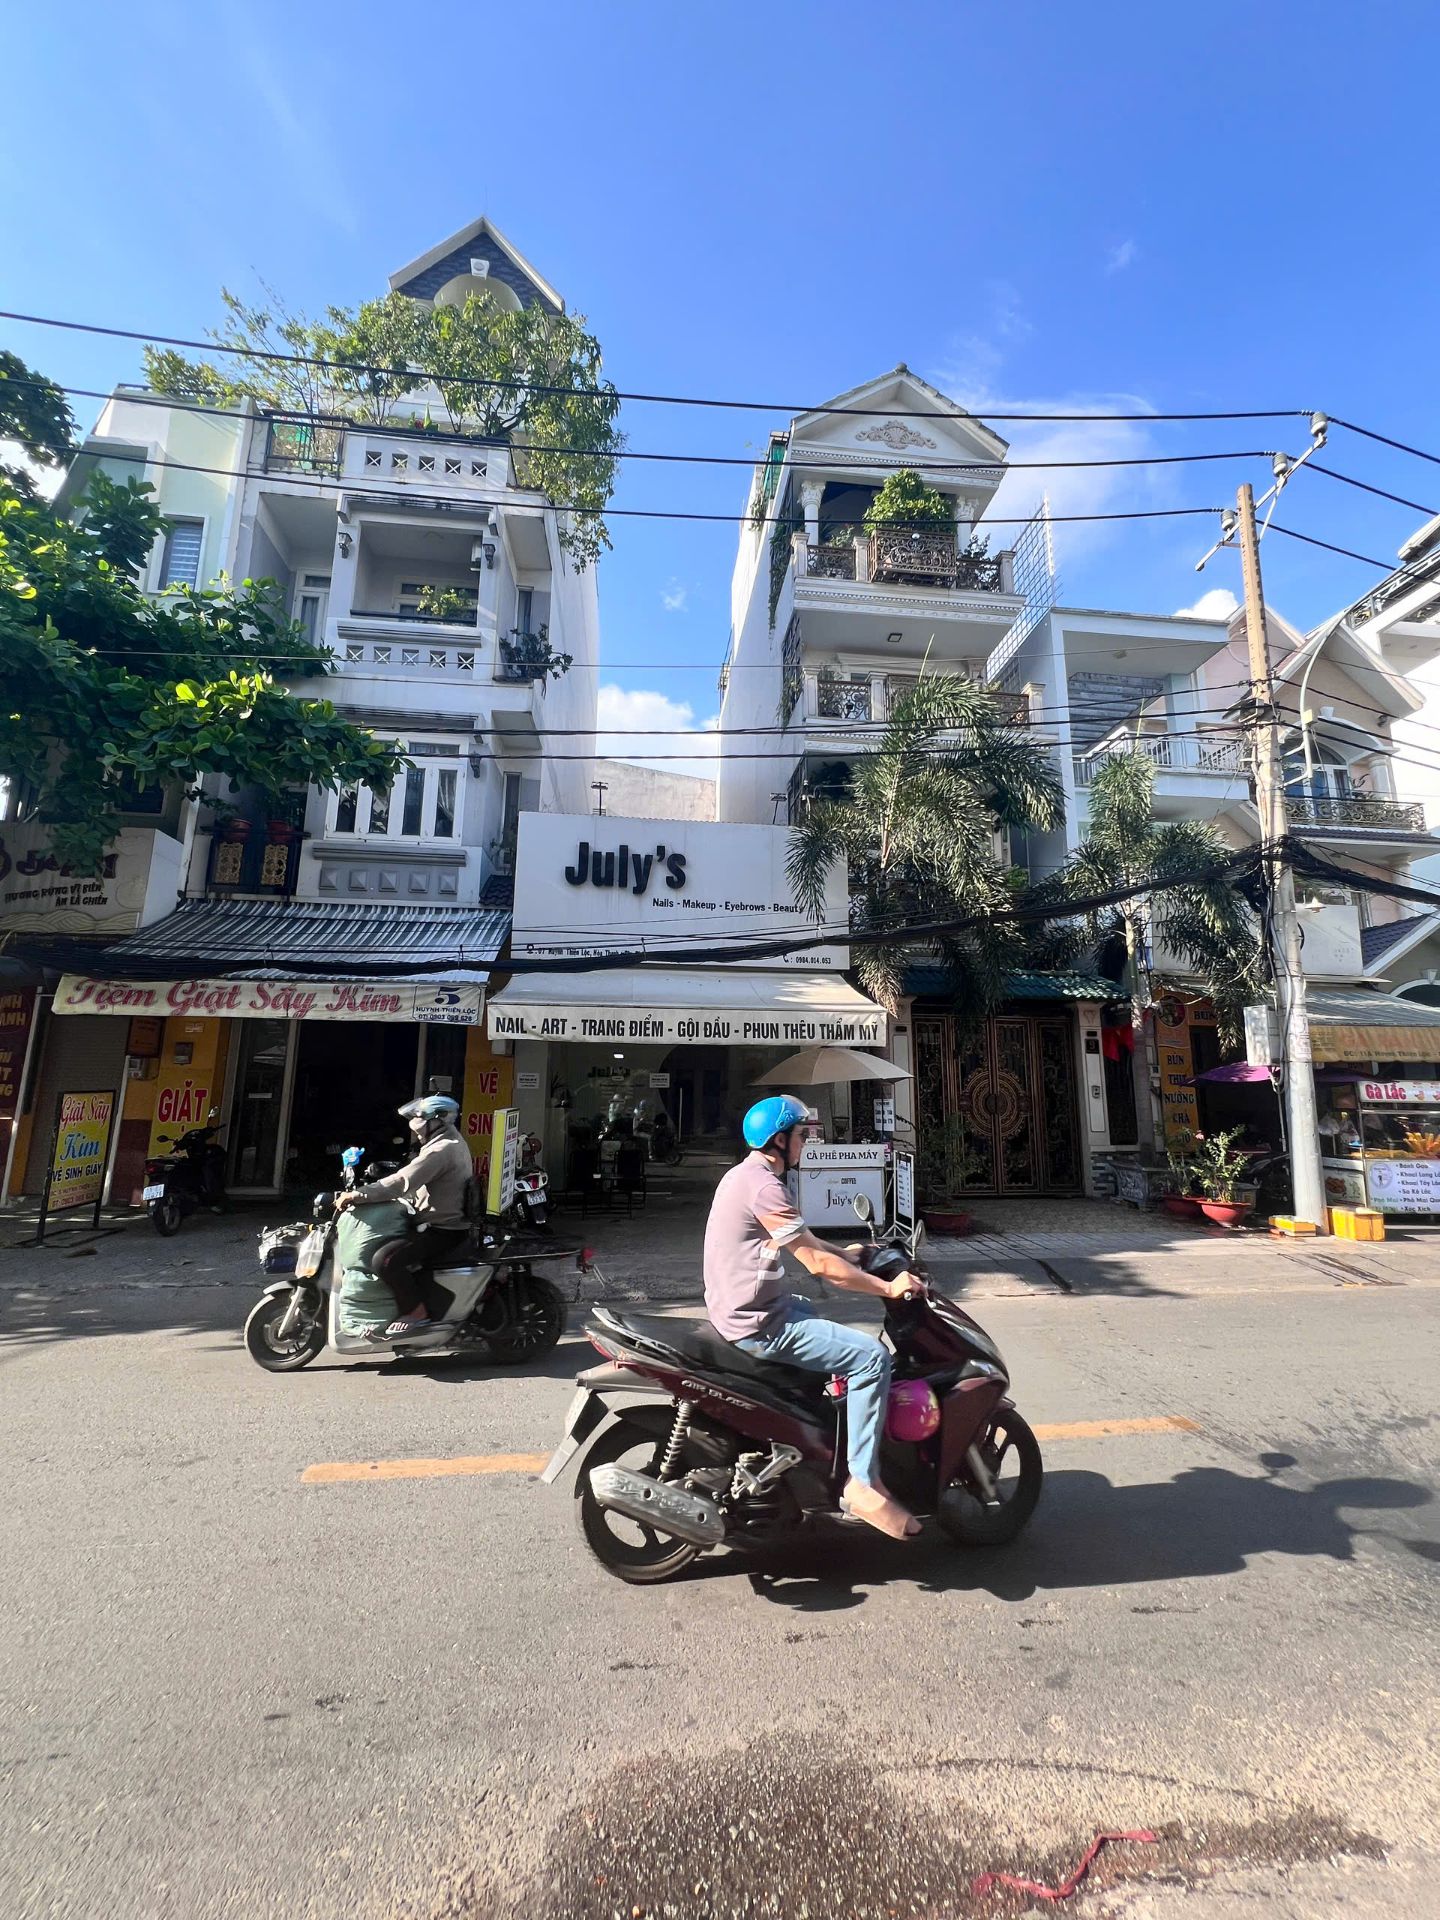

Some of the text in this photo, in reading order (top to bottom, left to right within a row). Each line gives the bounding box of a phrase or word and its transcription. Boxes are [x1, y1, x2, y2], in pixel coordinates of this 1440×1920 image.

[565, 842, 687, 895] July's
[652, 898, 674, 909] Nails
[682, 899, 716, 911] Makeup
[725, 901, 765, 913] Eyebrows
[67, 979, 404, 1018] Tiệm Giặt Sấy Kim
[434, 987, 461, 1005] 5
[496, 1016, 528, 1034] NAIL
[541, 1018, 567, 1035] ART
[581, 1019, 625, 1037] TRANG
[629, 1013, 664, 1038] ĐIỂM
[677, 1017, 699, 1041] GỘI
[703, 1016, 730, 1039] ĐẦU
[743, 1022, 779, 1039] PHUN
[783, 1019, 816, 1040] THÊU
[819, 1017, 855, 1041] THẨM
[859, 1021, 878, 1041] MỸ
[479, 1067, 500, 1099] VỆ
[1365, 1082, 1407, 1100] Gà Lắc
[158, 1080, 209, 1132] GIẶT
[60, 1132, 100, 1161] Kim
[806, 1149, 878, 1160] CÀ PHÊ PHA MÁY
[65, 1166, 83, 1181] SINH
[825, 1189, 852, 1209] July's
